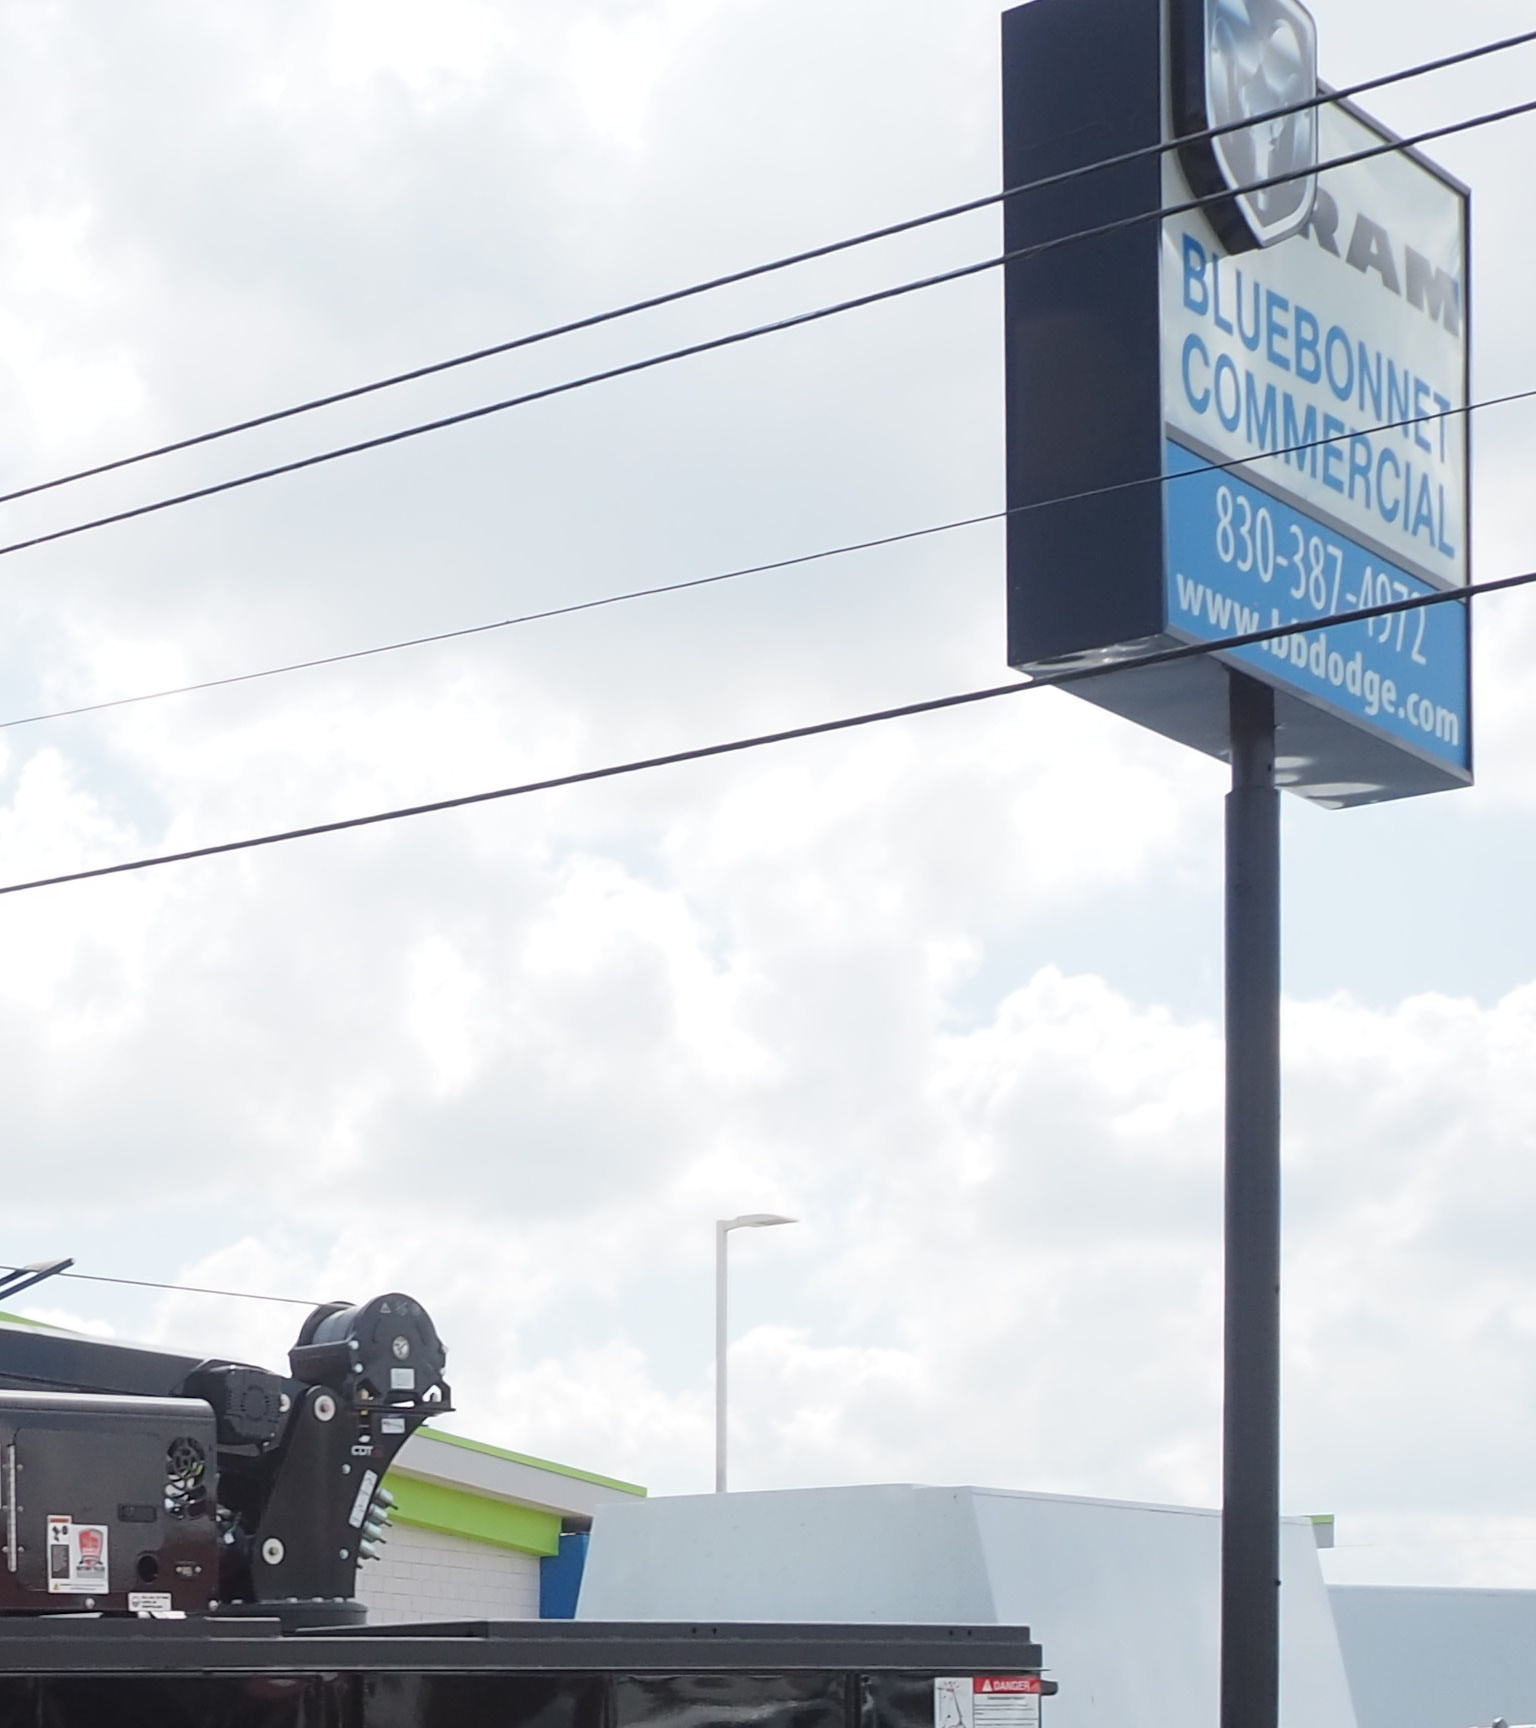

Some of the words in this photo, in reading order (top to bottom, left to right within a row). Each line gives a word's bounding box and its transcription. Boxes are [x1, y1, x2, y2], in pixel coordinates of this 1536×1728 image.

[1182, 232, 1452, 465] BLUEBONNET
[1296, 186, 1460, 338] RAM
[1181, 332, 1456, 560] COMMERCIAL
[1176, 572, 1460, 747] www.bbdodge.com
[1215, 485, 1428, 666] 830-387-4972
